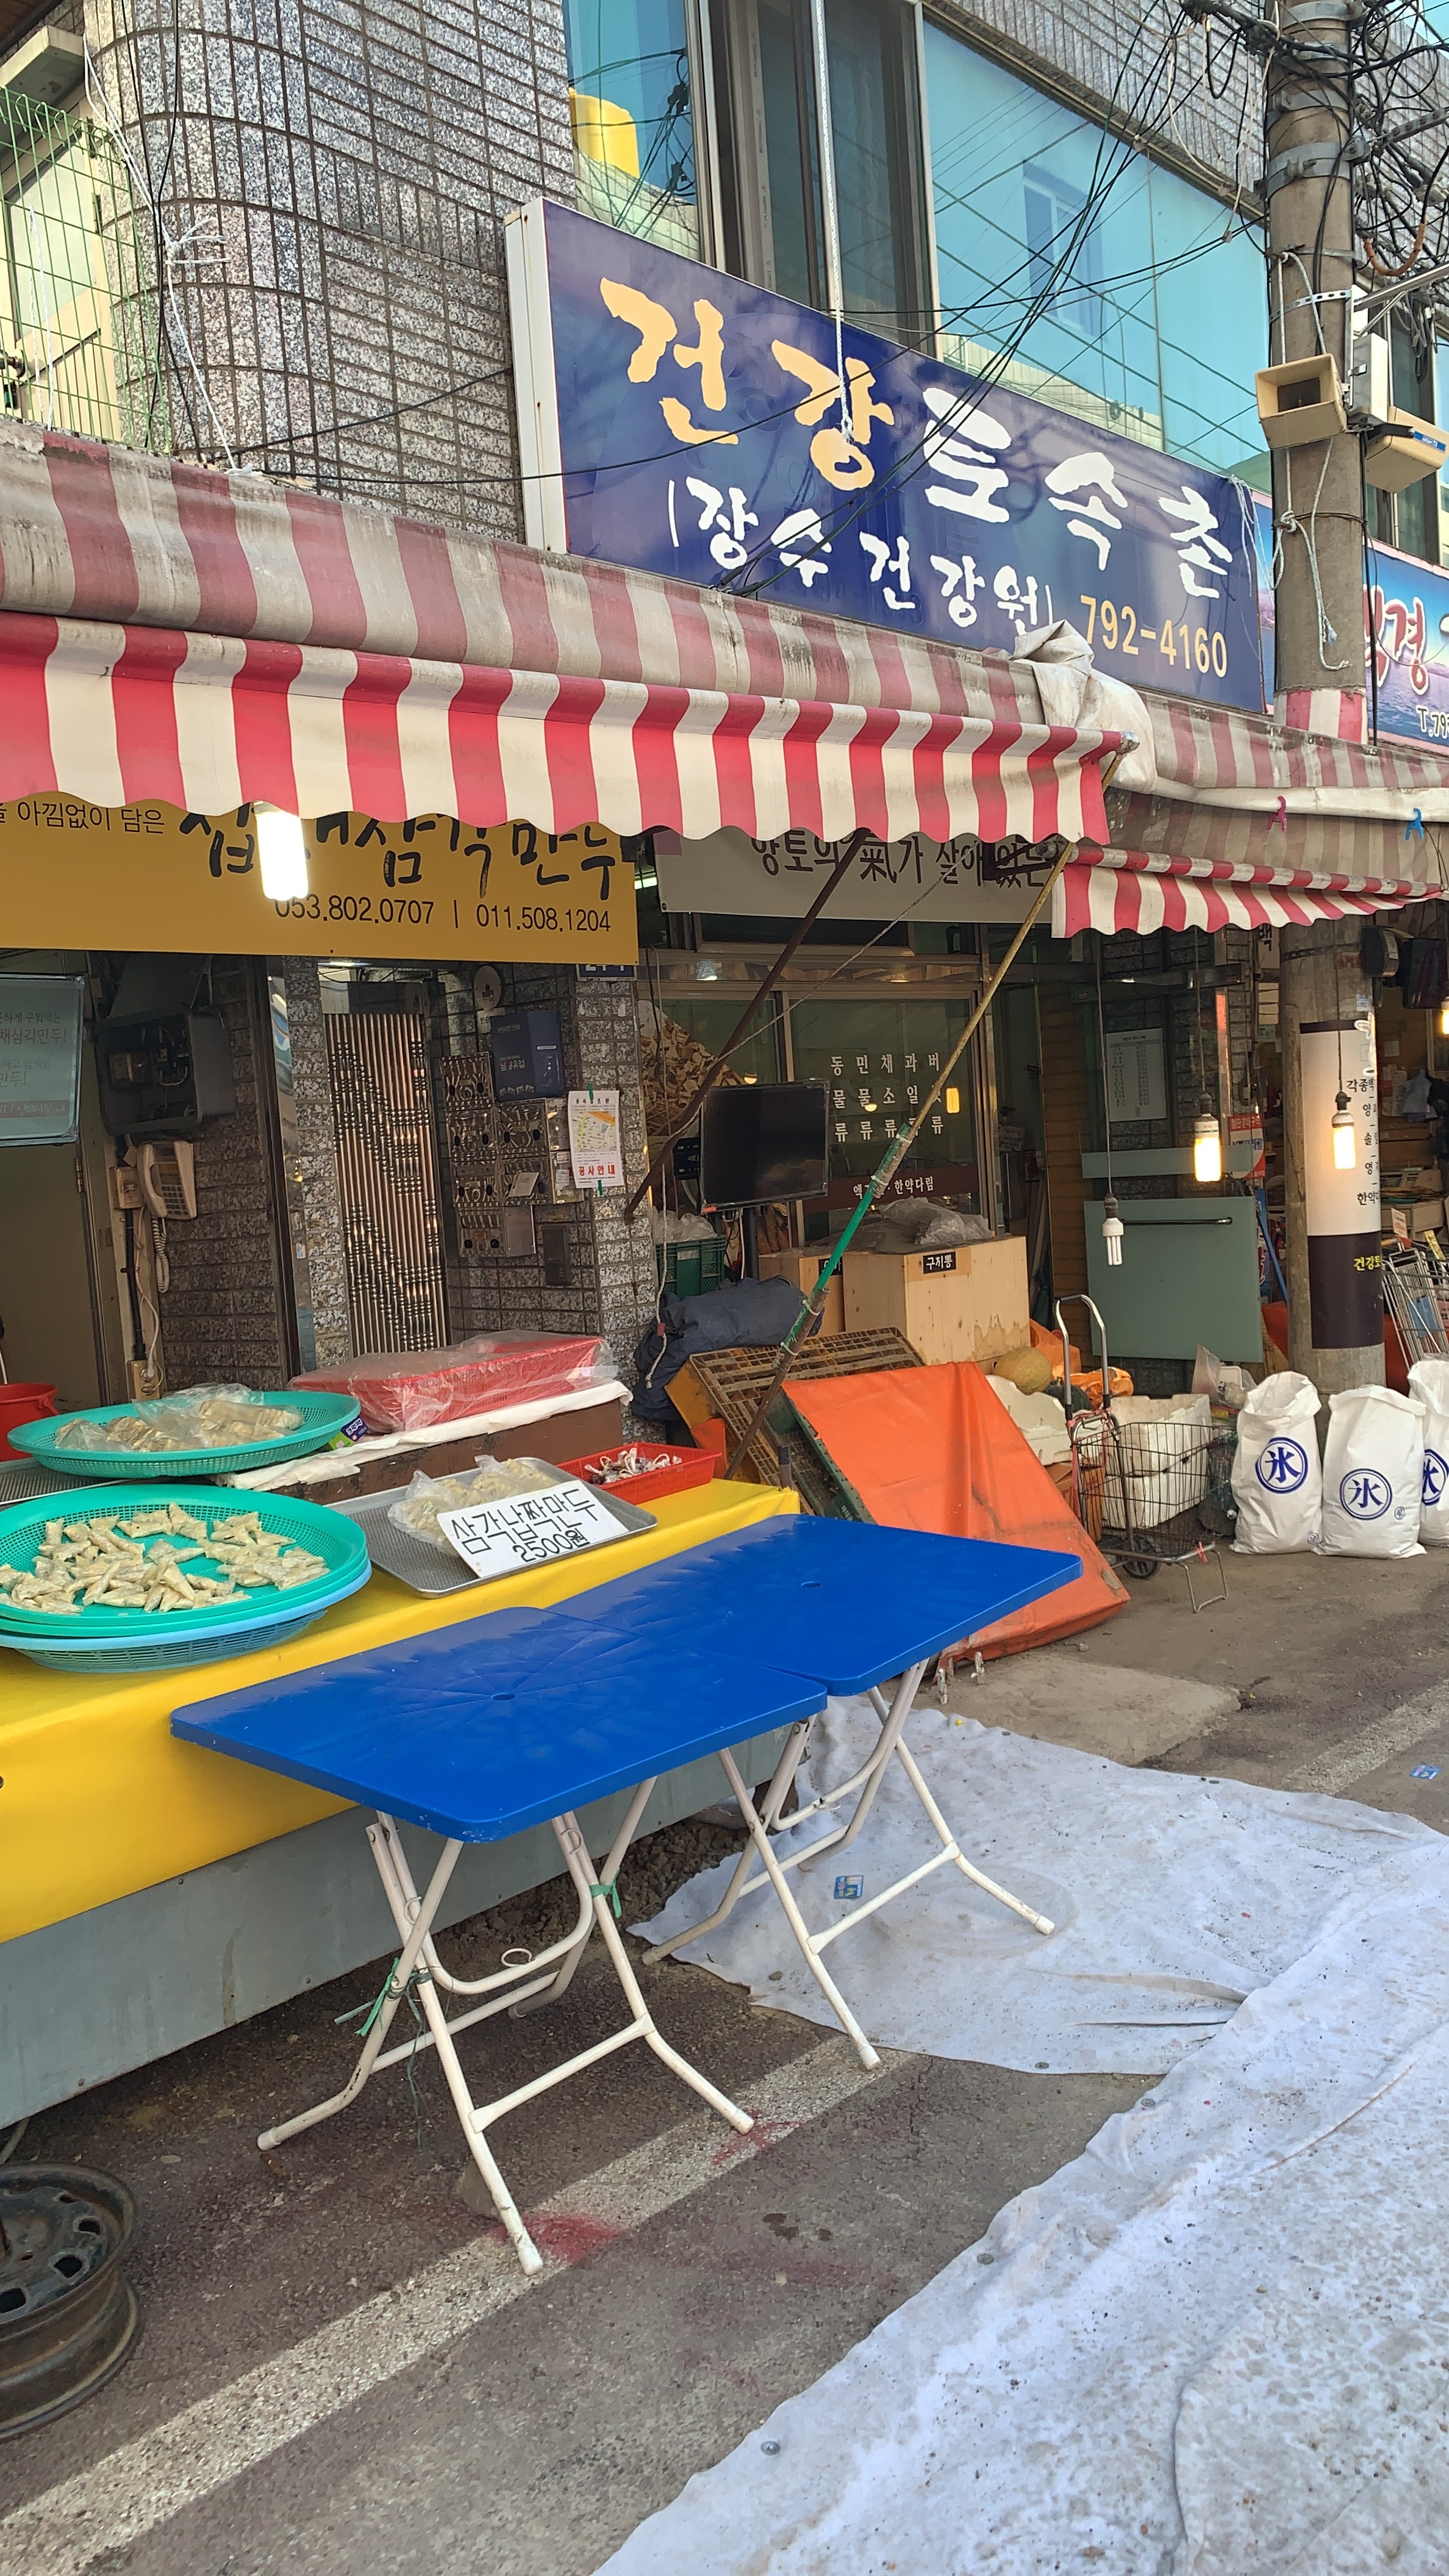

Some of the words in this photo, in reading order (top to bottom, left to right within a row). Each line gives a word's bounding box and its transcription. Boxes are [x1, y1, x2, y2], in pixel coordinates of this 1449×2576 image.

[1081, 596, 1228, 678] 792-4160
[1417, 707, 1449, 737] T.79
[17, 800, 111, 831] 아낌없이
[121, 807, 165, 834] 담은
[476, 904, 611, 932] 011.508.1204
[578, 1164, 615, 1176] 공사안내
[893, 1176, 934, 1195] 한약다림
[512, 1528, 590, 1563] 2500원
